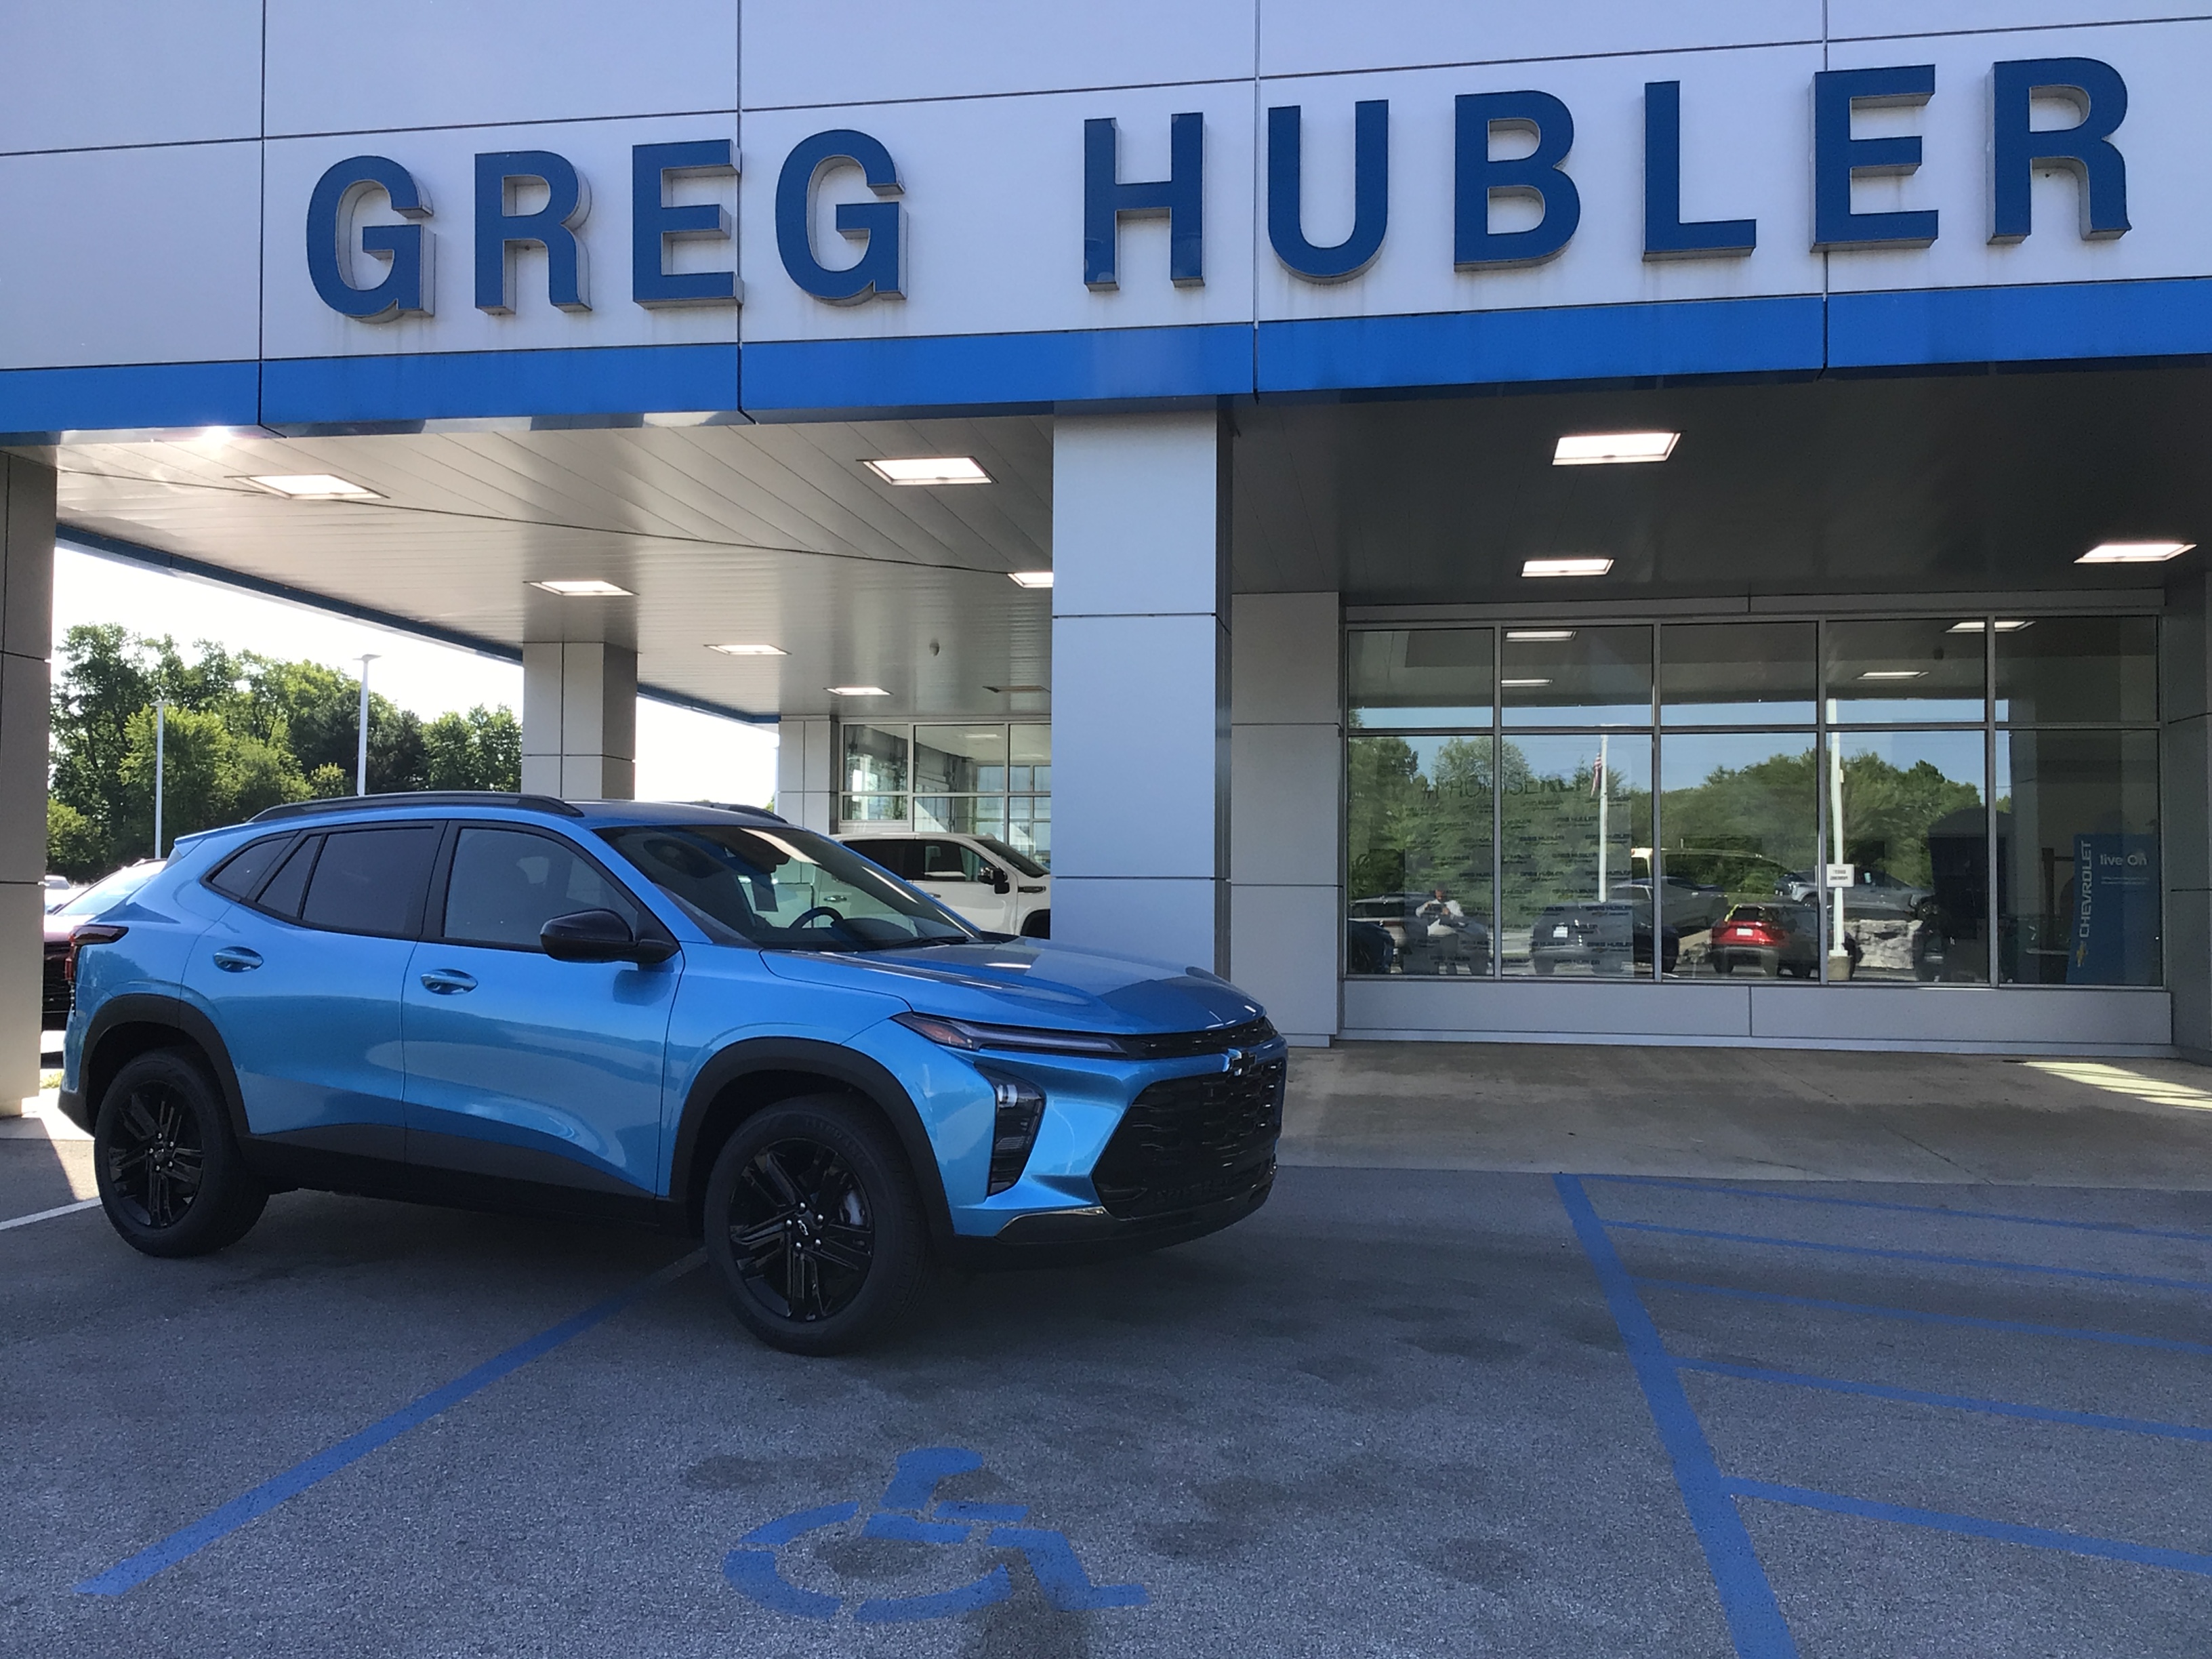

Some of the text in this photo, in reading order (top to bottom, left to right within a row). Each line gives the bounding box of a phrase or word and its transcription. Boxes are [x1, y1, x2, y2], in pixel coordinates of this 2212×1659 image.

[306, 57, 2132, 323] GREG HUBLER
[2079, 840, 2093, 938] CHEVROLET
[2100, 853, 2148, 866] live On
